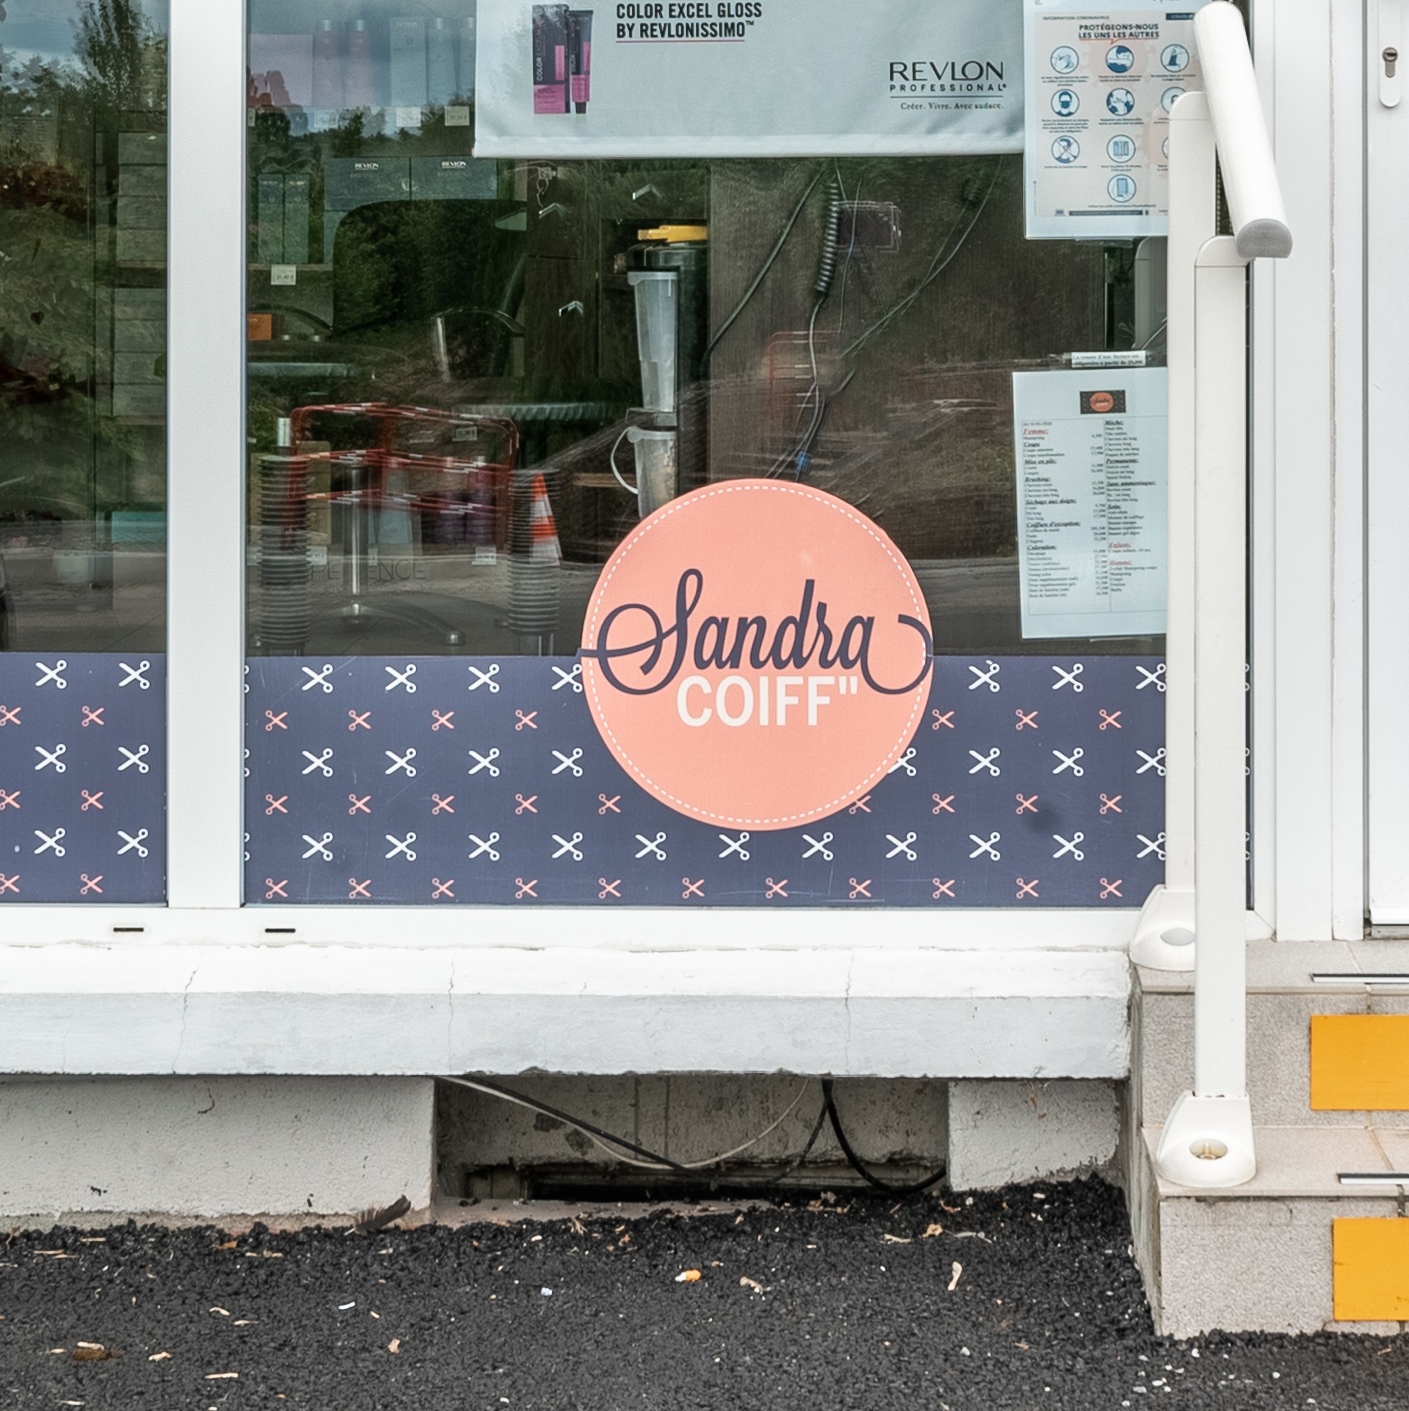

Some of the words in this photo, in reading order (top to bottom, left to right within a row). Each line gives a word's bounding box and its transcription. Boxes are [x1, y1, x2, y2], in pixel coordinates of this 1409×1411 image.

[616, 2, 664, 19] COLOR
[668, 2, 713, 19] EXCEL
[717, 1, 763, 18] GLOSS
[616, 23, 634, 39] BY
[1079, 22, 1159, 30] PROTÉGEONS-NOUS
[1128, 30, 1160, 38] AUTRES
[889, 60, 1004, 82] REVLON
[900, 102, 926, 110] Créer.
[928, 102, 952, 110] Vivre.
[954, 102, 973, 110] Avec
[975, 101, 1004, 110] audace.
[577, 568, 934, 695] Sandra
